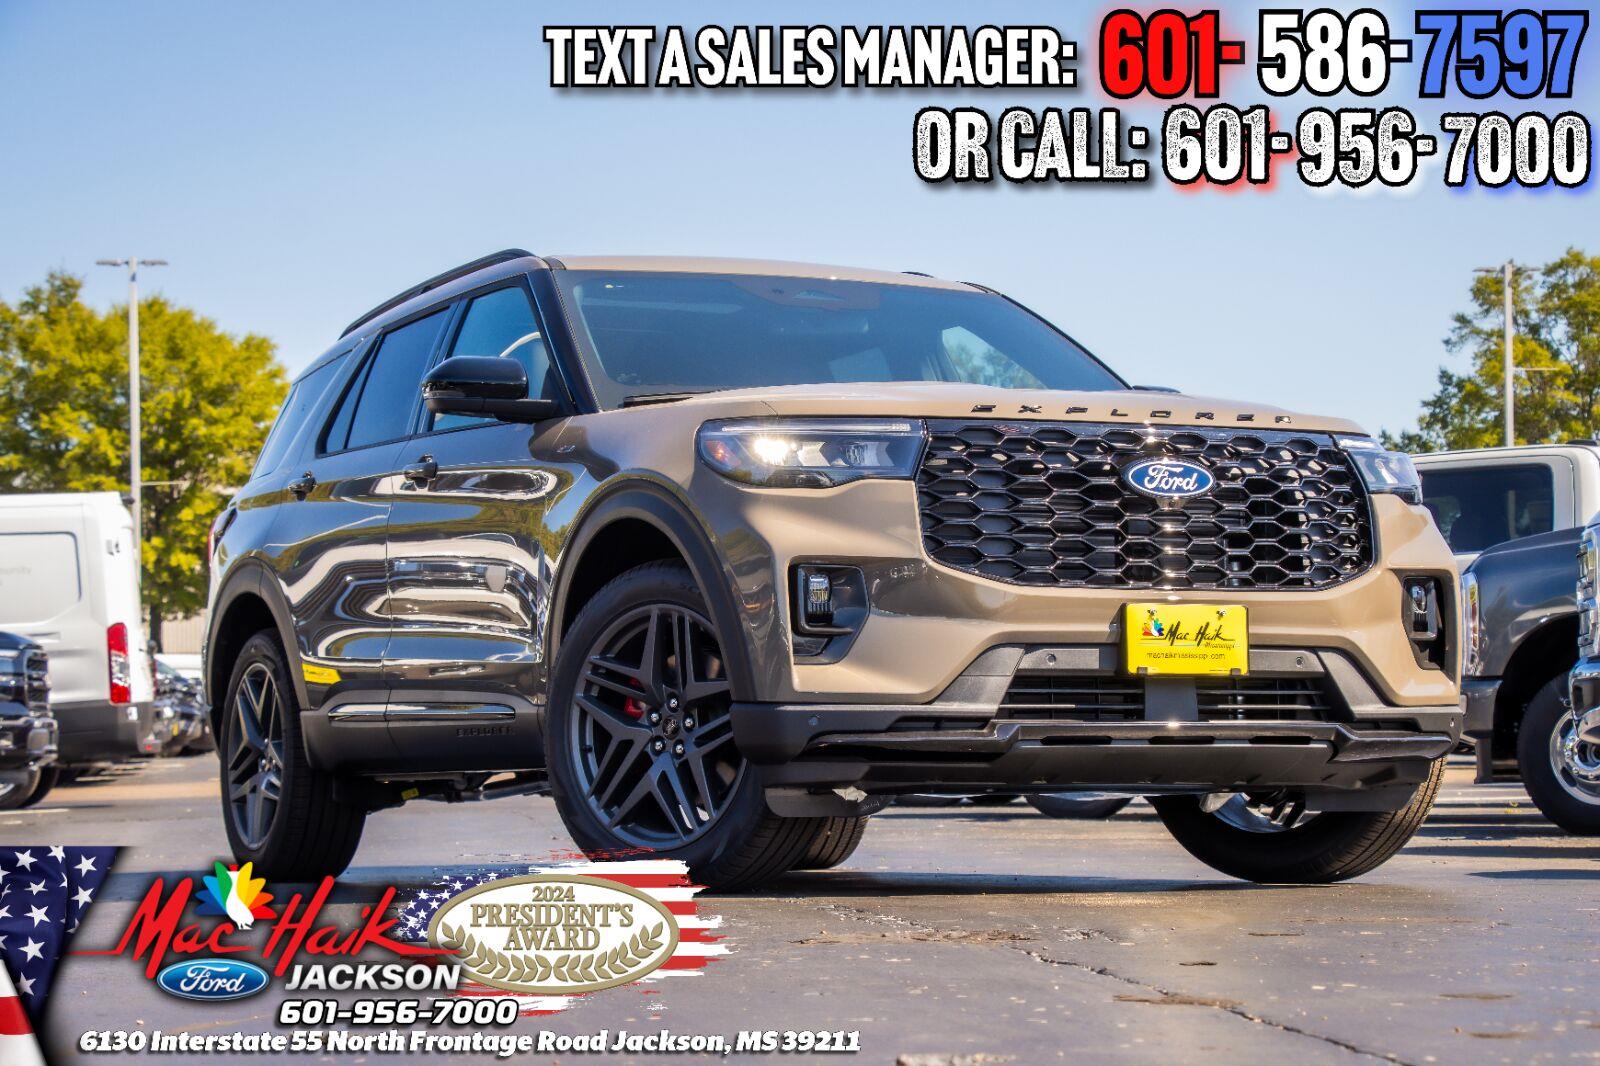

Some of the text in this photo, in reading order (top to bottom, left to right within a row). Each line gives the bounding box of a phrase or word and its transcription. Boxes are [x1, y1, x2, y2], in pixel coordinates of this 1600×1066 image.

[971, 404, 1292, 424] EXPLORER
[1144, 464, 1198, 491] Ford
[1163, 620, 1230, 647] Mac Haik
